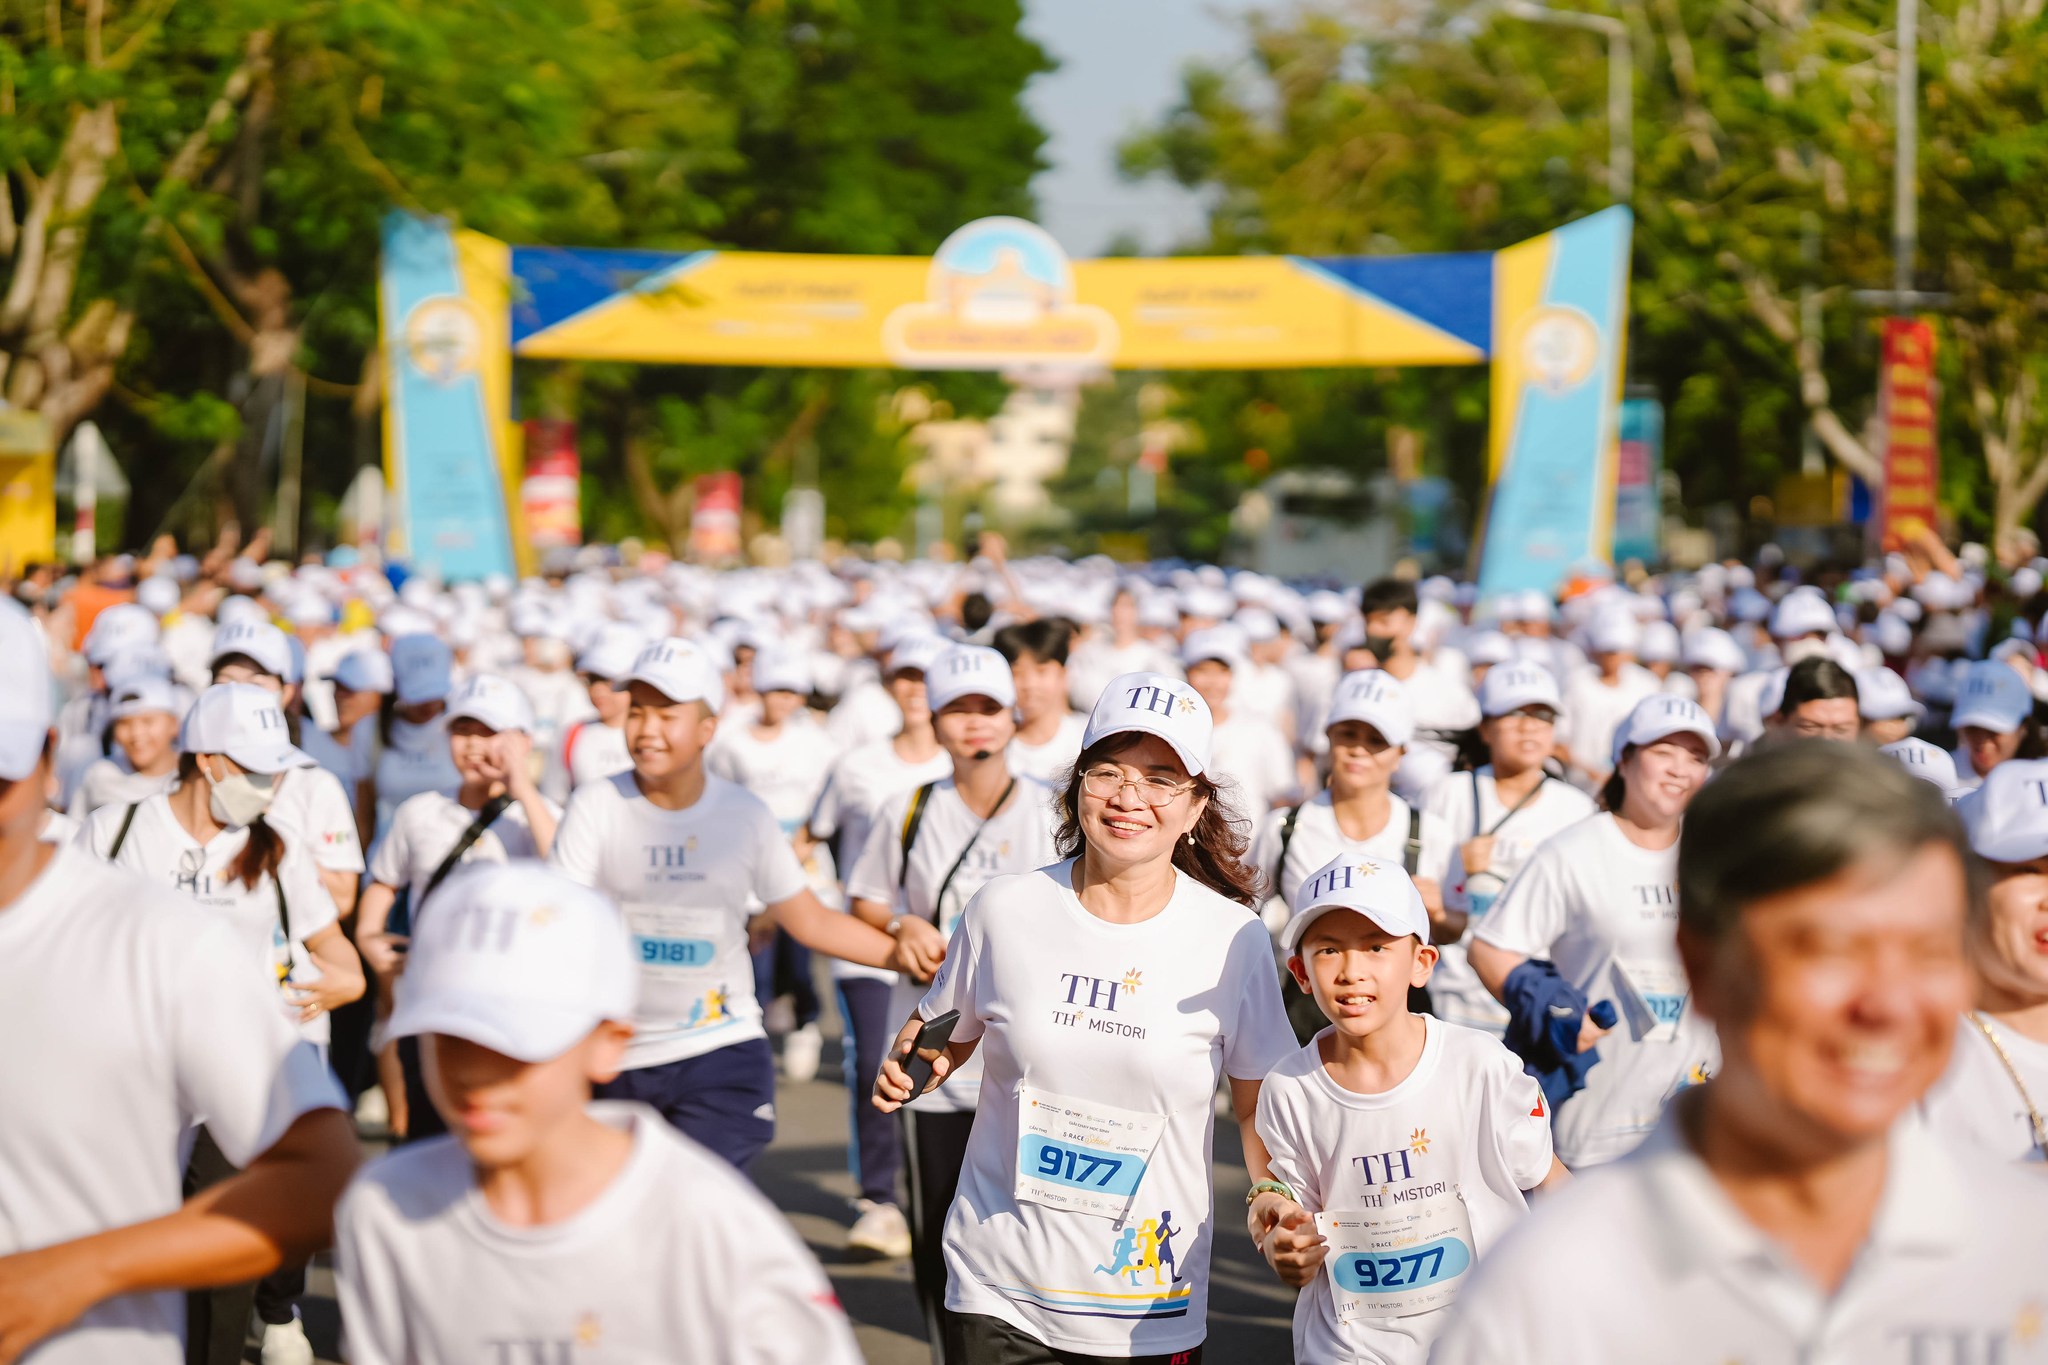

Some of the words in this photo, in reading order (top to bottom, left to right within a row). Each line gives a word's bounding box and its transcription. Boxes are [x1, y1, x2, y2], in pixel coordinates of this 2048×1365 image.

[1125, 686, 1178, 719] TH
[643, 845, 686, 867] TH
[1307, 864, 1355, 902] TH
[642, 940, 695, 962] 9181
[1060, 972, 1122, 1013] TH
[1052, 1010, 1076, 1028] TH
[1088, 1018, 1146, 1040] MISTORI
[1038, 1145, 1122, 1187] 9177
[1352, 1148, 1416, 1186] TH
[1044, 1192, 1068, 1203] MISTORI
[1361, 1194, 1383, 1207] TH
[1393, 1181, 1446, 1205] MISTORI
[1354, 1246, 1445, 1287] 9277
[1341, 1303, 1355, 1312] TH
